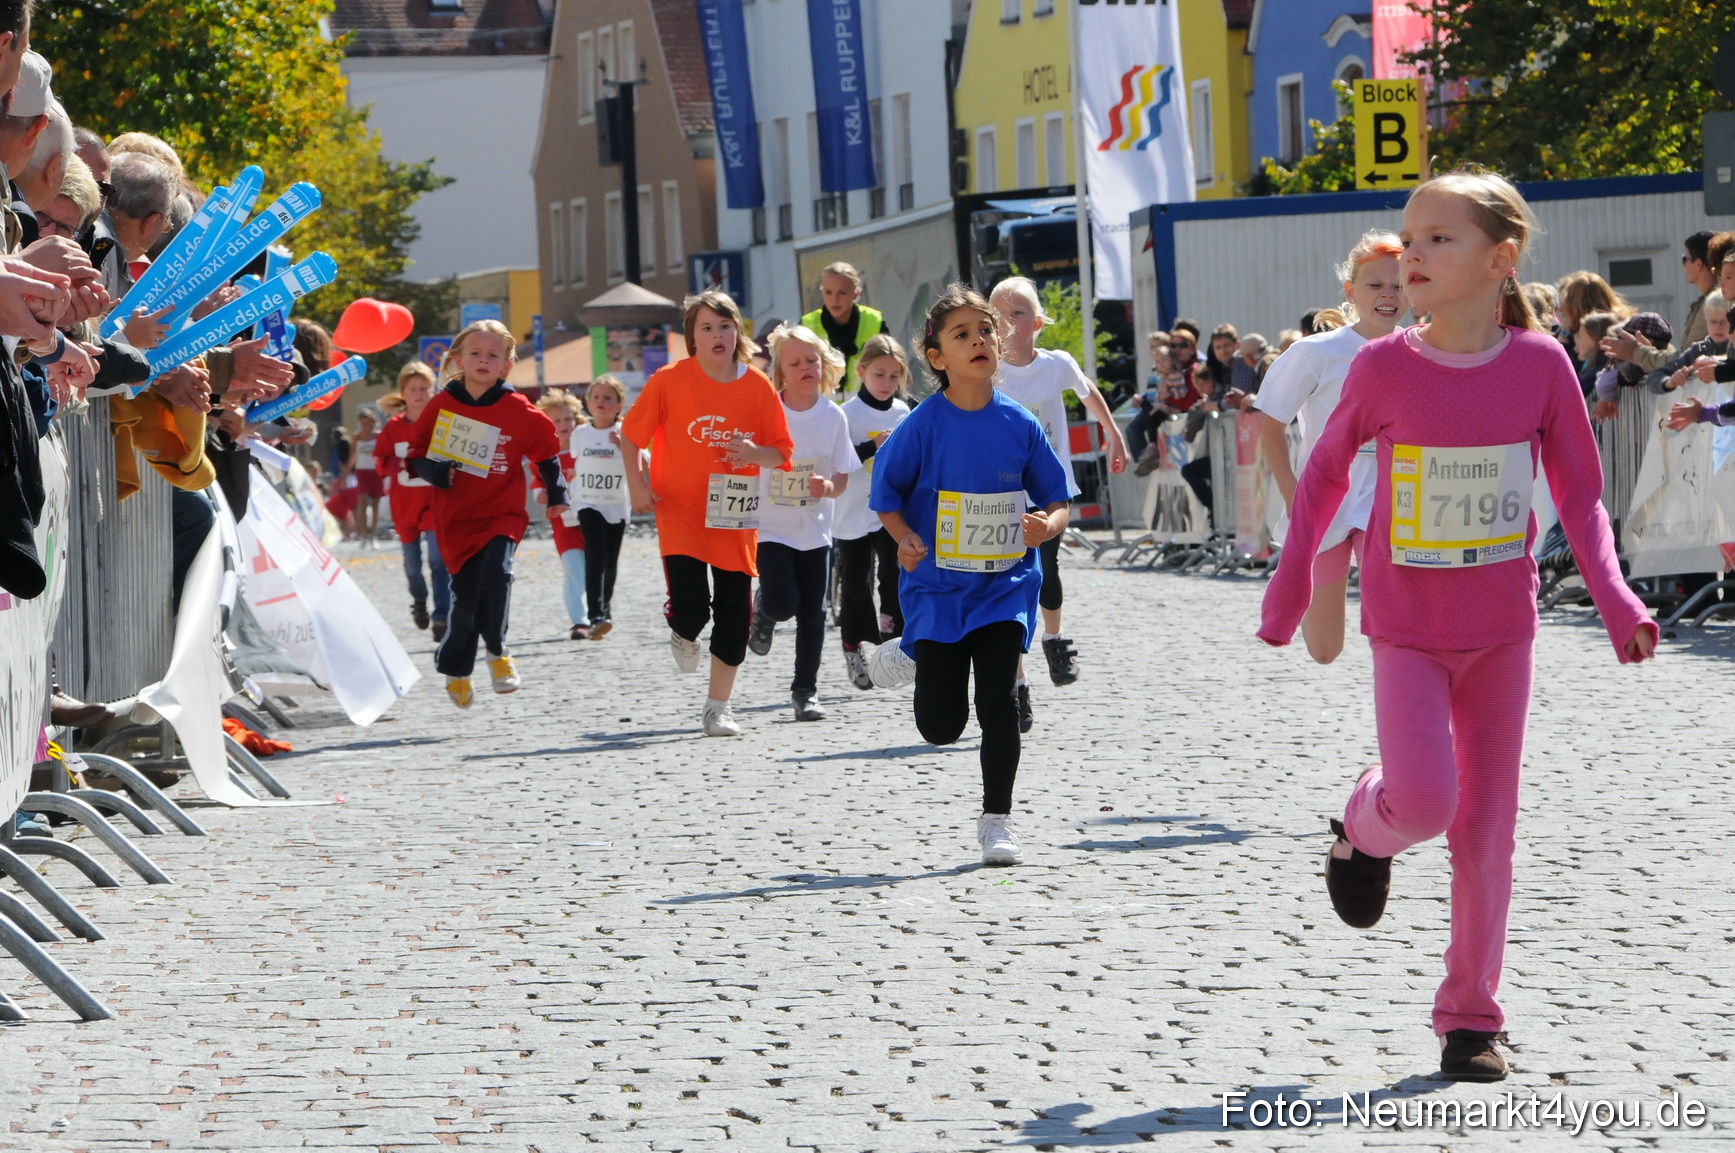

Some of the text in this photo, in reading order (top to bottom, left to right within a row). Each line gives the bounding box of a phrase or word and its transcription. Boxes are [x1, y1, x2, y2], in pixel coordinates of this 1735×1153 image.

[1023, 64, 1059, 105] HOTEL
[1363, 83, 1418, 103] Block
[844, 97, 862, 146] K&L
[1373, 112, 1410, 165] B
[150, 292, 284, 376] www.maxi-dsl.de
[452, 418, 473, 435] Lucy
[1043, 421, 1054, 438] 4
[449, 434, 489, 460] 7193
[791, 462, 815, 473] ndrea
[1427, 456, 1499, 480] Antonia
[580, 473, 623, 490] 10207
[727, 479, 748, 491] Anna
[787, 477, 810, 492] 71
[710, 493, 720, 502] K3
[726, 496, 760, 513] 7123
[1396, 490, 1412, 508] K3
[965, 499, 1016, 516] Valentina
[1429, 490, 1521, 527] 7196
[940, 521, 953, 534] K3
[965, 523, 1021, 547] 7207
[1478, 540, 1523, 557] PFLEIDERER
